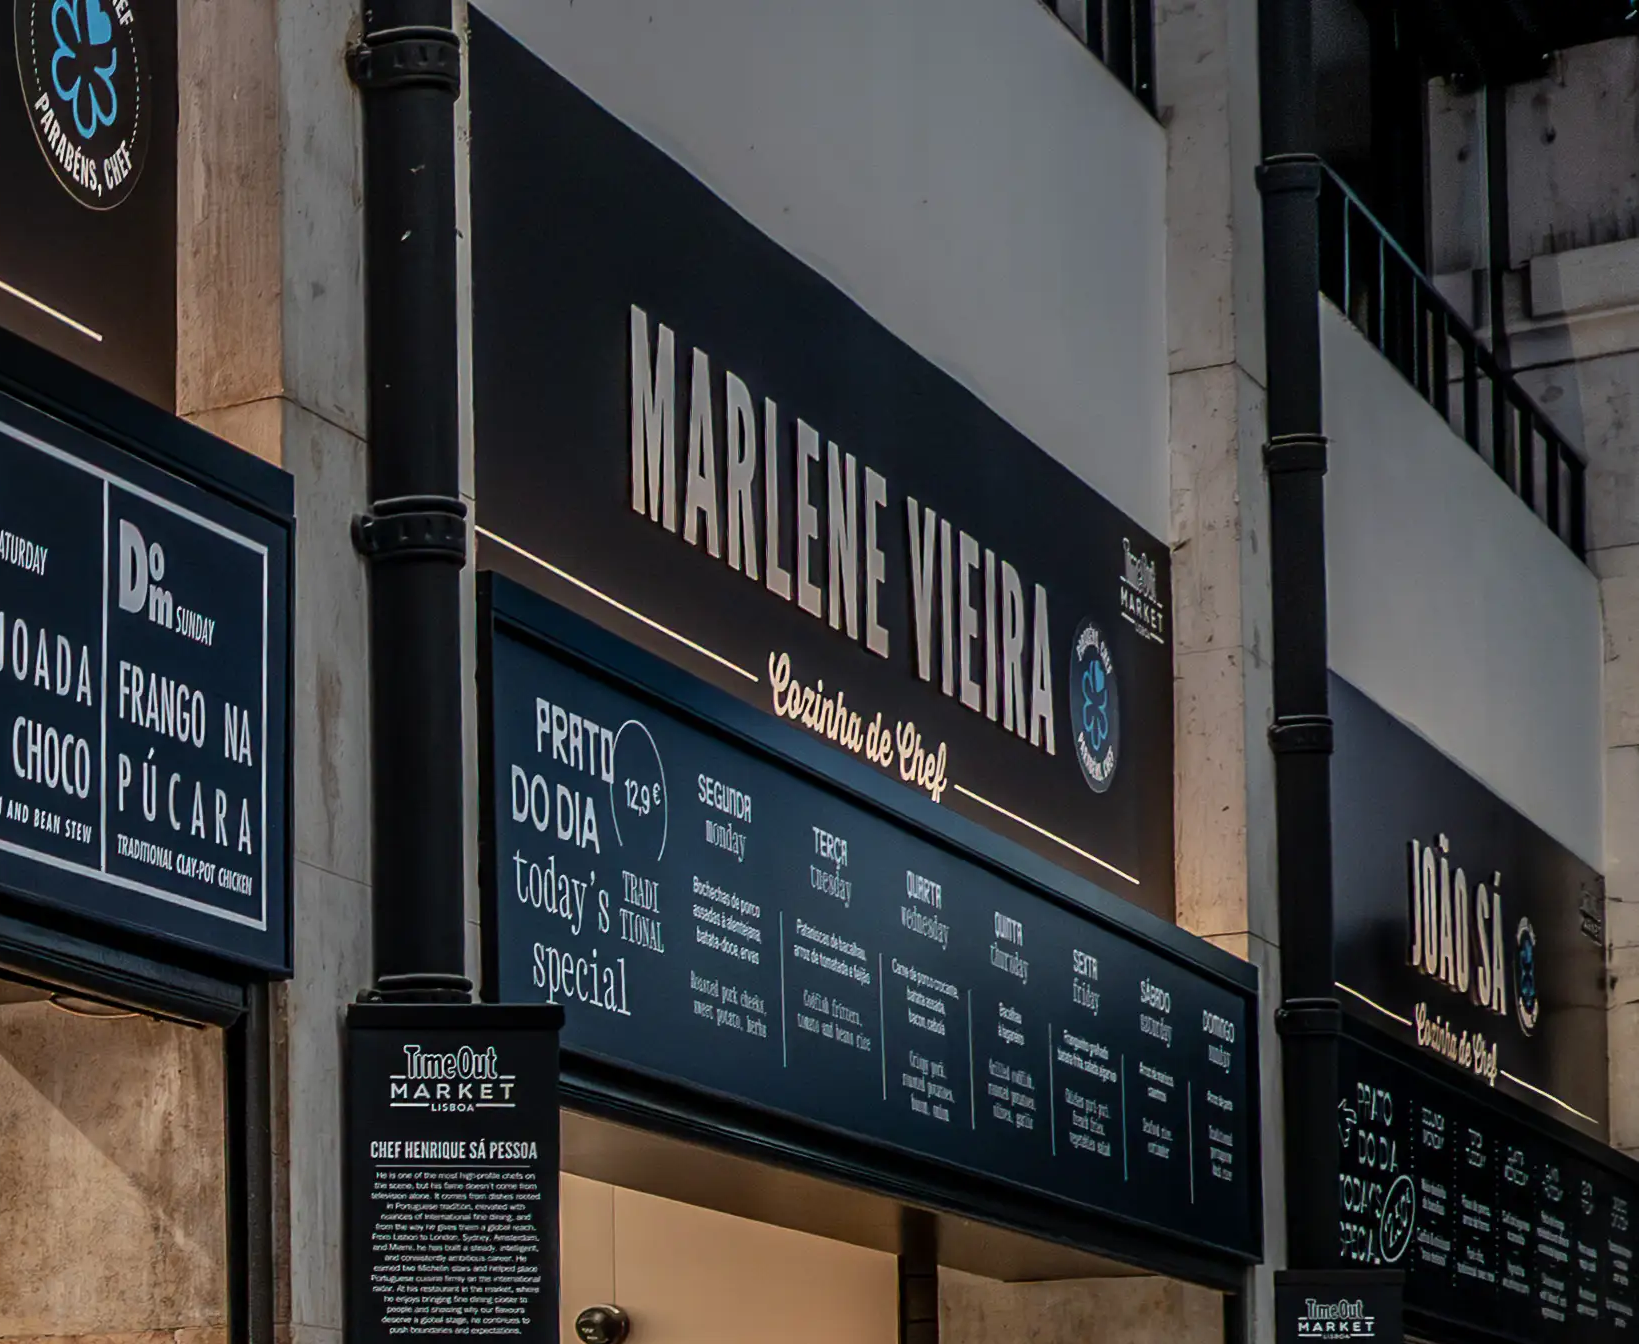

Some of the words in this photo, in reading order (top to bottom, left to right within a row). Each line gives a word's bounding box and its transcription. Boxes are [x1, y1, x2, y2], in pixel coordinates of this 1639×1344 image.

[103, 140, 132, 190] CHEF
[629, 303, 889, 659] MARLENE
[906, 495, 1056, 756] VIEIRA
[176, 606, 215, 647] SUNDAY
[1121, 586, 1163, 632] MARKET
[119, 660, 206, 749] FRANGO
[225, 702, 253, 768] NA
[768, 650, 863, 753] Cozinha
[865, 711, 893, 768] de
[896, 721, 948, 802] Chef
[12, 715, 90, 800] CHOCO
[536, 697, 614, 784] PRATO
[7, 799, 29, 825] AND
[34, 808, 60, 834] BEAN
[65, 819, 92, 844] STEW
[118, 748, 253, 856] PÚCARA
[511, 764, 550, 832] DO
[556, 783, 600, 854] DIA
[698, 773, 752, 824] SEGUNDA
[705, 819, 746, 863] monday
[513, 849, 610, 935] today's
[622, 870, 659, 914] TRADI
[810, 864, 852, 908] tuesday
[620, 908, 664, 953] TIONAL
[901, 905, 950, 951] wednesday
[1407, 833, 1470, 993] JOÃO
[1476, 871, 1507, 1016] SÁ
[533, 942, 631, 1016] special
[1414, 1002, 1458, 1068] Cozinha
[1458, 1040, 1472, 1069] de
[1473, 1032, 1498, 1086] Chef
[389, 1083, 514, 1100] MARKET
[431, 1103, 475, 1112] LISBOA
[370, 1141, 402, 1159] CHEF
[404, 1141, 465, 1160] HENRIQUE
[469, 1138, 486, 1159] SÁ
[489, 1141, 538, 1159] PESSOA
[1298, 1322, 1374, 1332] MARKET
